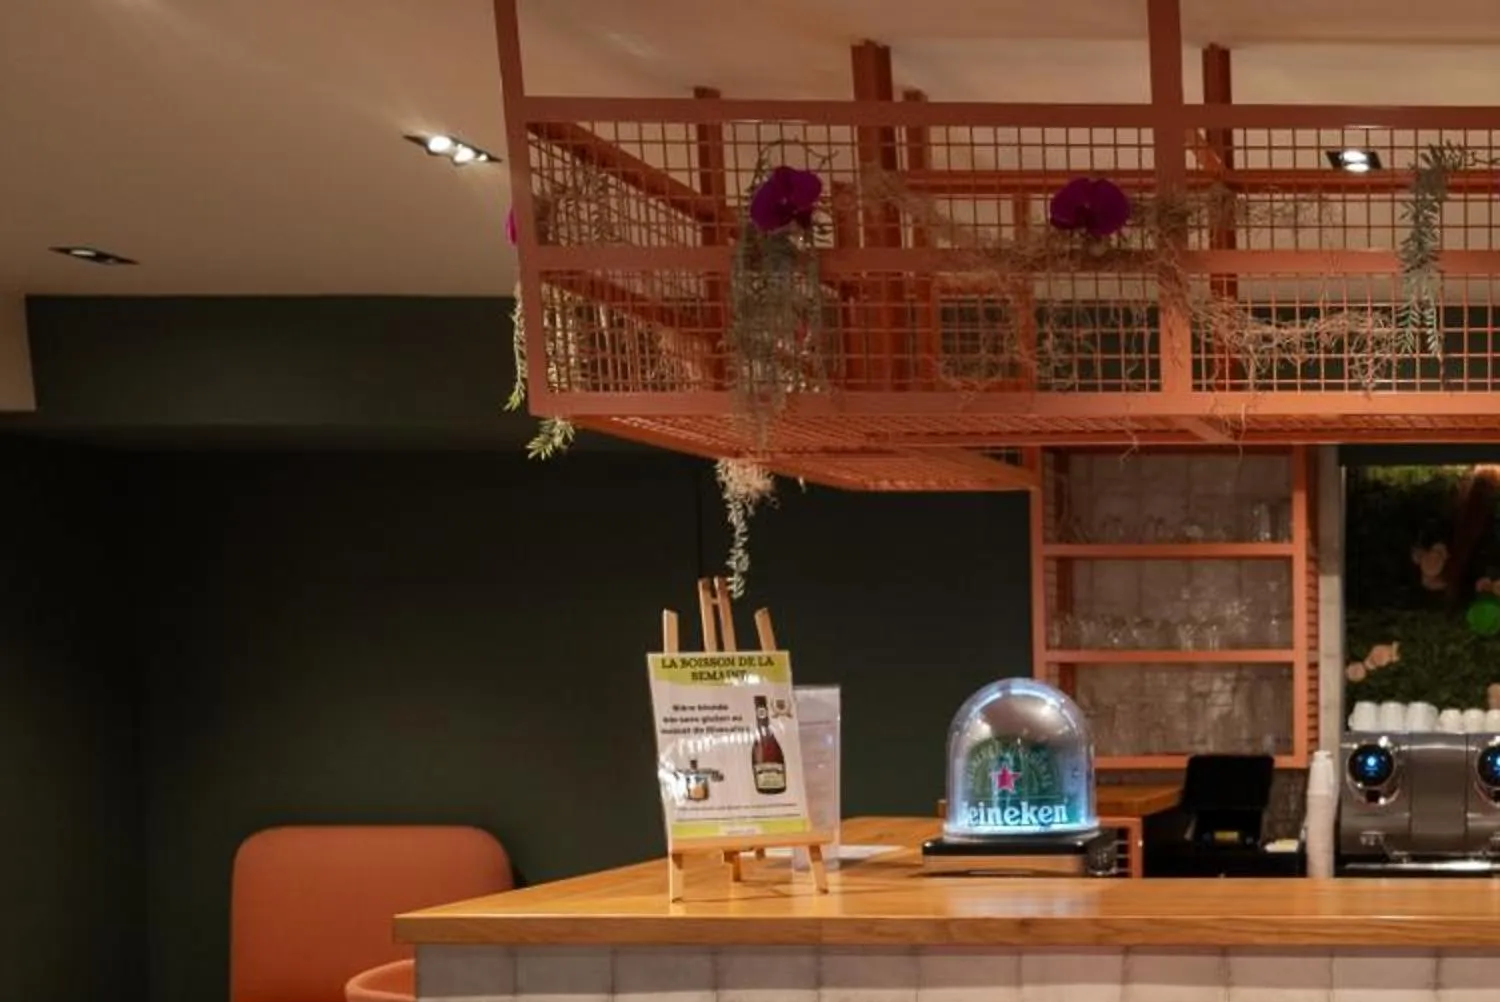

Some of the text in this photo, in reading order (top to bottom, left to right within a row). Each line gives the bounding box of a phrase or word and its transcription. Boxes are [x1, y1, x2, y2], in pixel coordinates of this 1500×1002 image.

[661, 655, 775, 669] LA BOISSON DE LA
